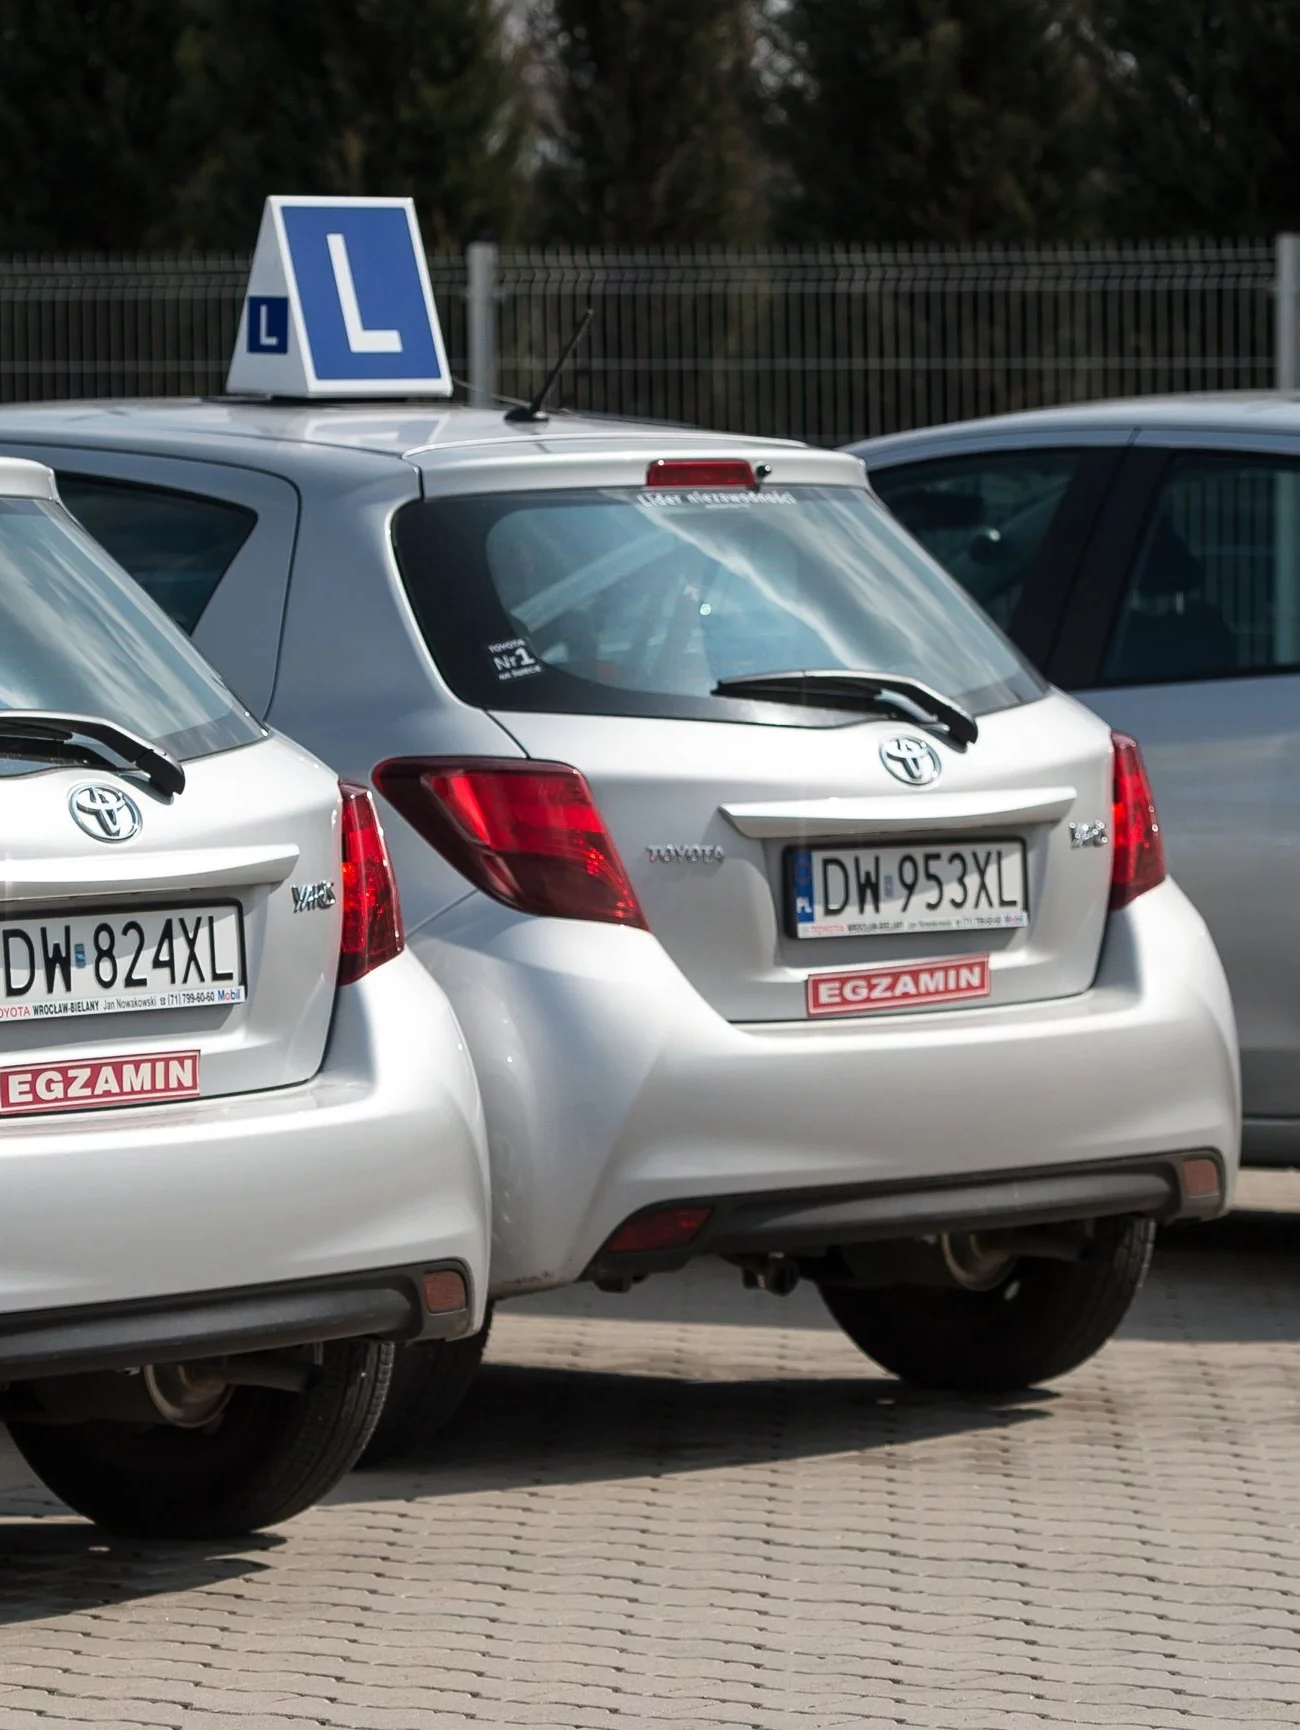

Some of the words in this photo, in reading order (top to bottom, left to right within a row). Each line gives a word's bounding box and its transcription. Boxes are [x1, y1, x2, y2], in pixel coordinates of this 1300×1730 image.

[326, 233, 403, 353] L
[260, 304, 278, 346] L
[822, 855, 880, 917] DW
[897, 849, 1017, 913] 953XL
[2, 925, 71, 997] DW
[93, 915, 234, 989] 824XL
[32, 1000, 99, 1016] WROCŁAW-BIELANY
[103, 999, 116, 1010] Jan
[116, 996, 157, 1009] Nowakowski
[217, 988, 240, 1001] Mobil
[818, 966, 981, 1005] EGZAMIN
[8, 1059, 193, 1104] EGZAMIN
